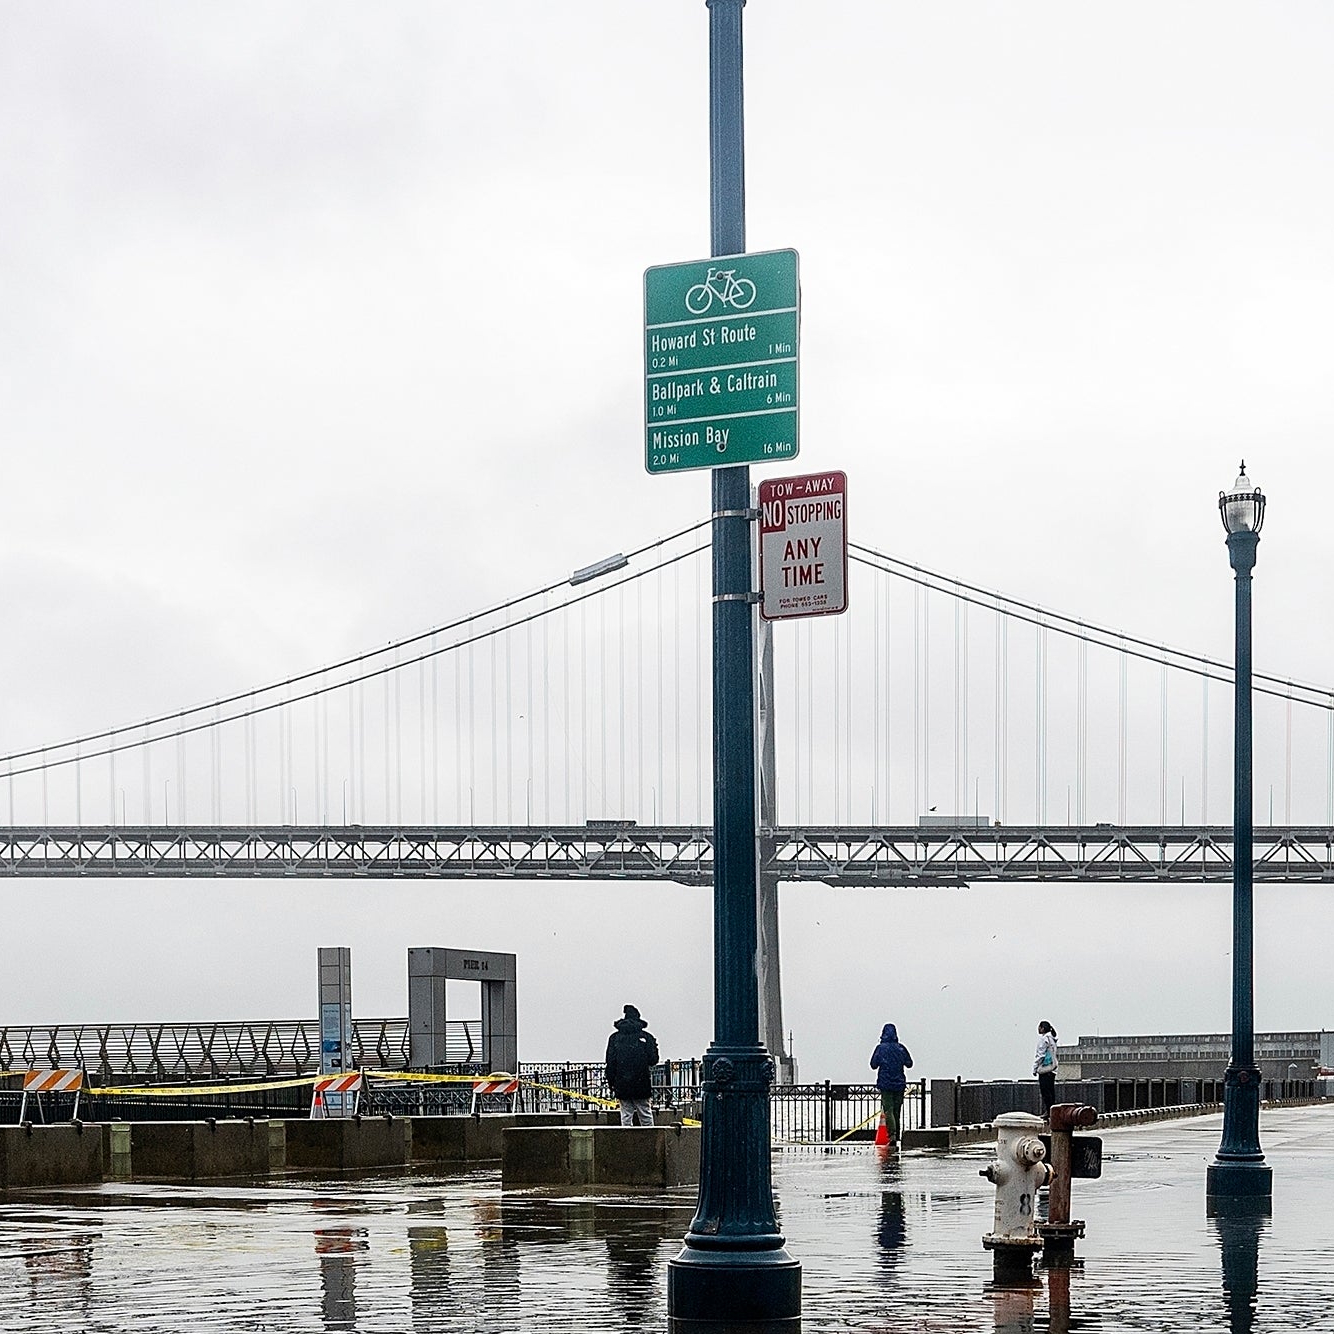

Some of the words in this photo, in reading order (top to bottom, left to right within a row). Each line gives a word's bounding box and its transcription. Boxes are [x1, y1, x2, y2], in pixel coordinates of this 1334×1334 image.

[652, 330, 697, 353] Howard
[702, 327, 716, 346] St
[721, 323, 756, 343] Route
[775, 344, 791, 354] Min
[652, 357, 666, 369] 0.2
[668, 355, 679, 367] Mi
[652, 379, 704, 401] Ballpark
[709, 376, 721, 394] &
[727, 370, 777, 392] Caltrain
[766, 394, 773, 404] 6
[775, 392, 791, 403] Min
[652, 405, 664, 417] 1.0
[667, 404, 677, 415] Mi
[653, 429, 699, 450] Mission
[706, 426, 730, 444] Bay
[763, 443, 773, 454] 16
[775, 442, 792, 452] Min
[653, 454, 667, 466] 2.0
[669, 453, 680, 464] Mi
[762, 500, 783, 528] NO
[787, 500, 841, 525] STOPPING
[783, 536, 822, 561] ANY
[781, 563, 825, 588] TIME
[1020, 1193, 1032, 1216] 8
